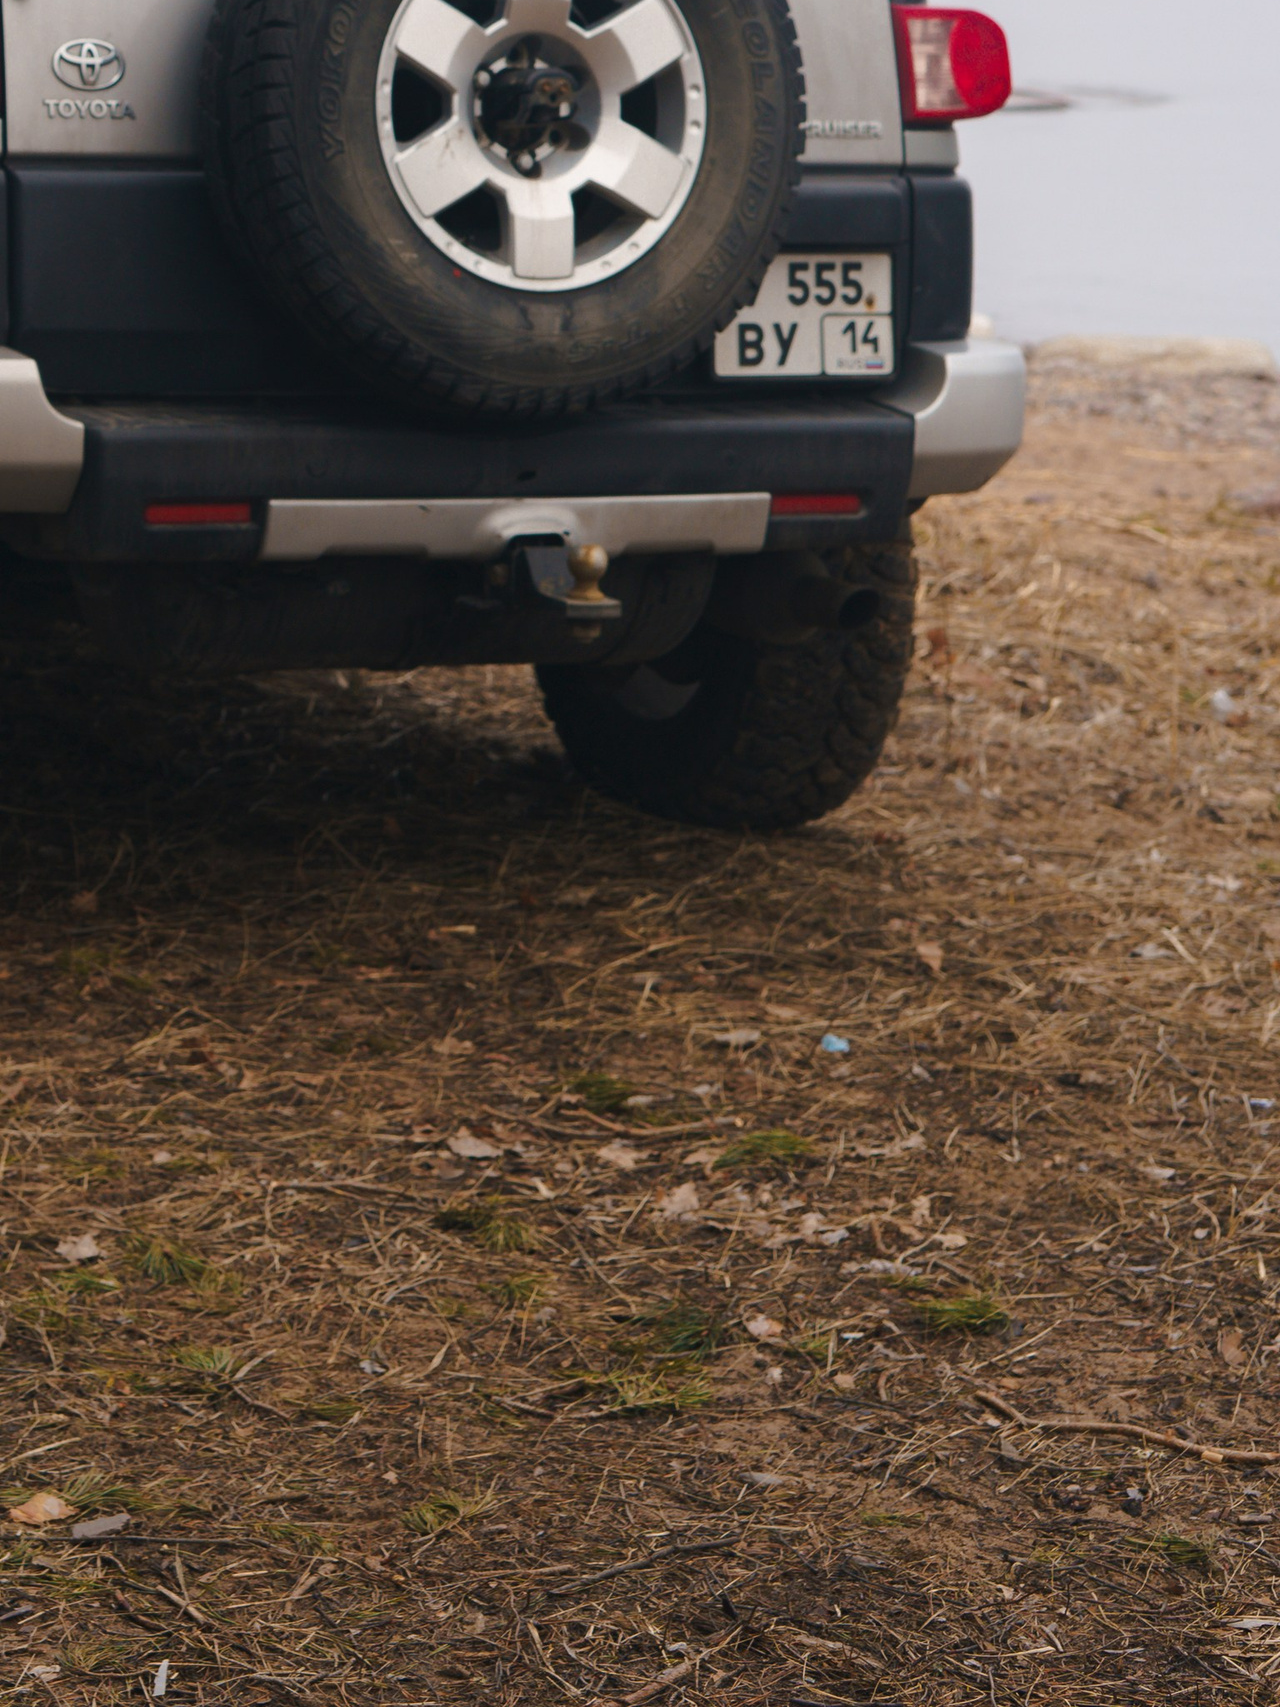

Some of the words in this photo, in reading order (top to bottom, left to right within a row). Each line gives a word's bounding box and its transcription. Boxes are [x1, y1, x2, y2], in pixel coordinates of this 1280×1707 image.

[43, 99, 136, 120] TOYOTA
[787, 261, 863, 306] 555
[842, 320, 878, 354] 14
